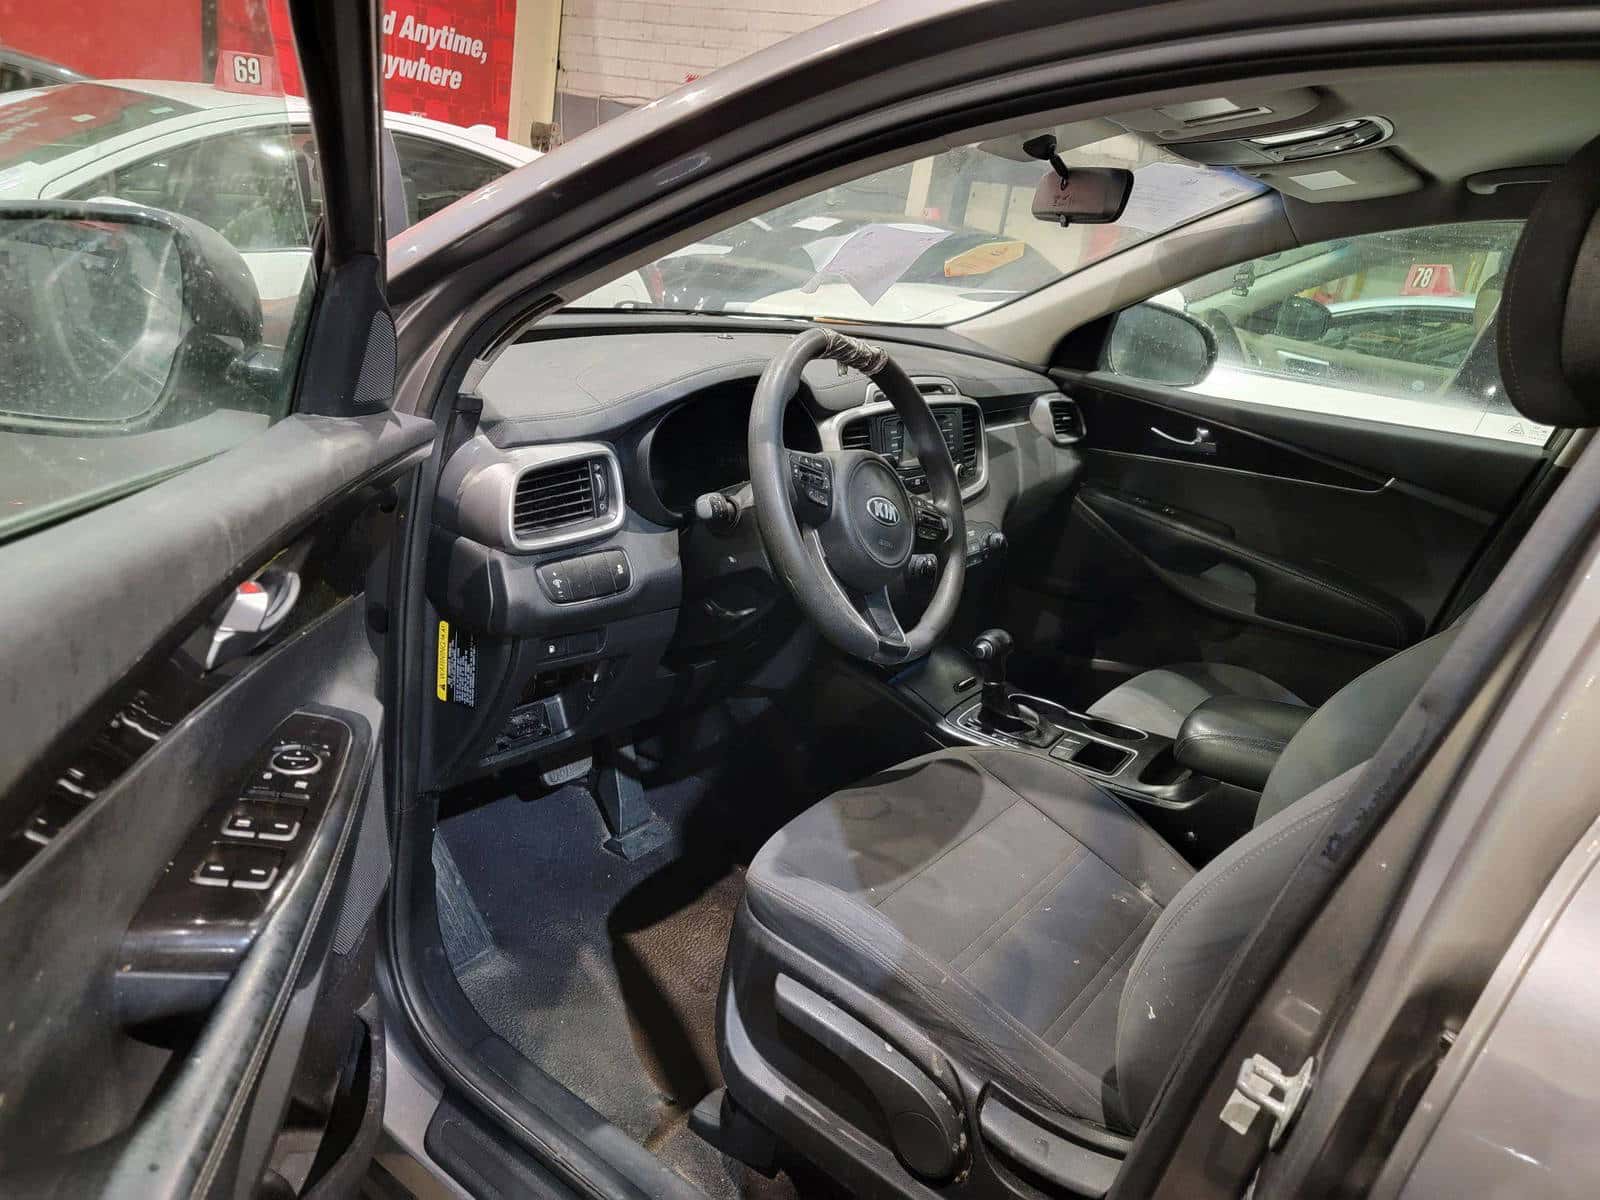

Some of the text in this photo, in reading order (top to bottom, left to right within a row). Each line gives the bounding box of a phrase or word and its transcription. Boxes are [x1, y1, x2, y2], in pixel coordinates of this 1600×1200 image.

[399, 15, 487, 64] Anytime,
[233, 55, 260, 84] 69
[1412, 268, 1435, 289] 78
[873, 500, 897, 522] KIA
